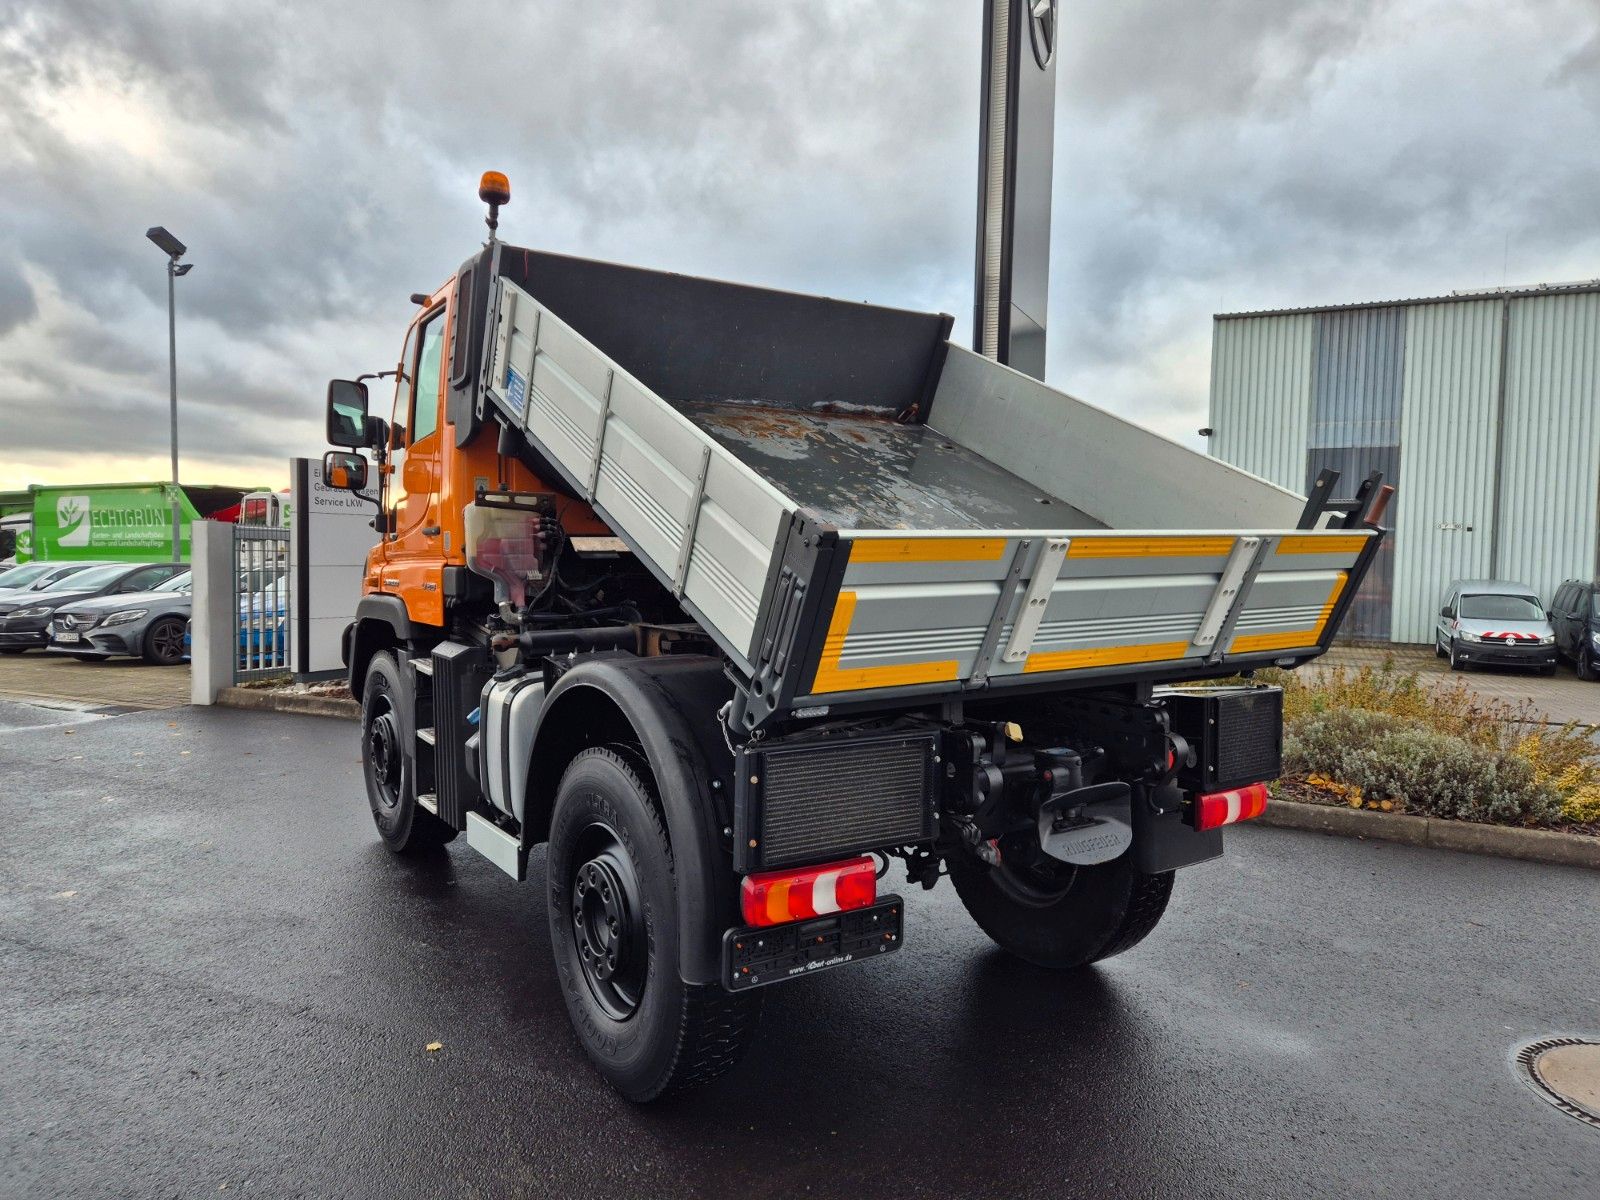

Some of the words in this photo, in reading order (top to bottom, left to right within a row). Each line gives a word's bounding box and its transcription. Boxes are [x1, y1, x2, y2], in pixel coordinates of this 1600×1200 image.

[314, 496, 344, 507] Service
[345, 498, 364, 508] LKW
[92, 504, 166, 528] ECHTGRÜN
